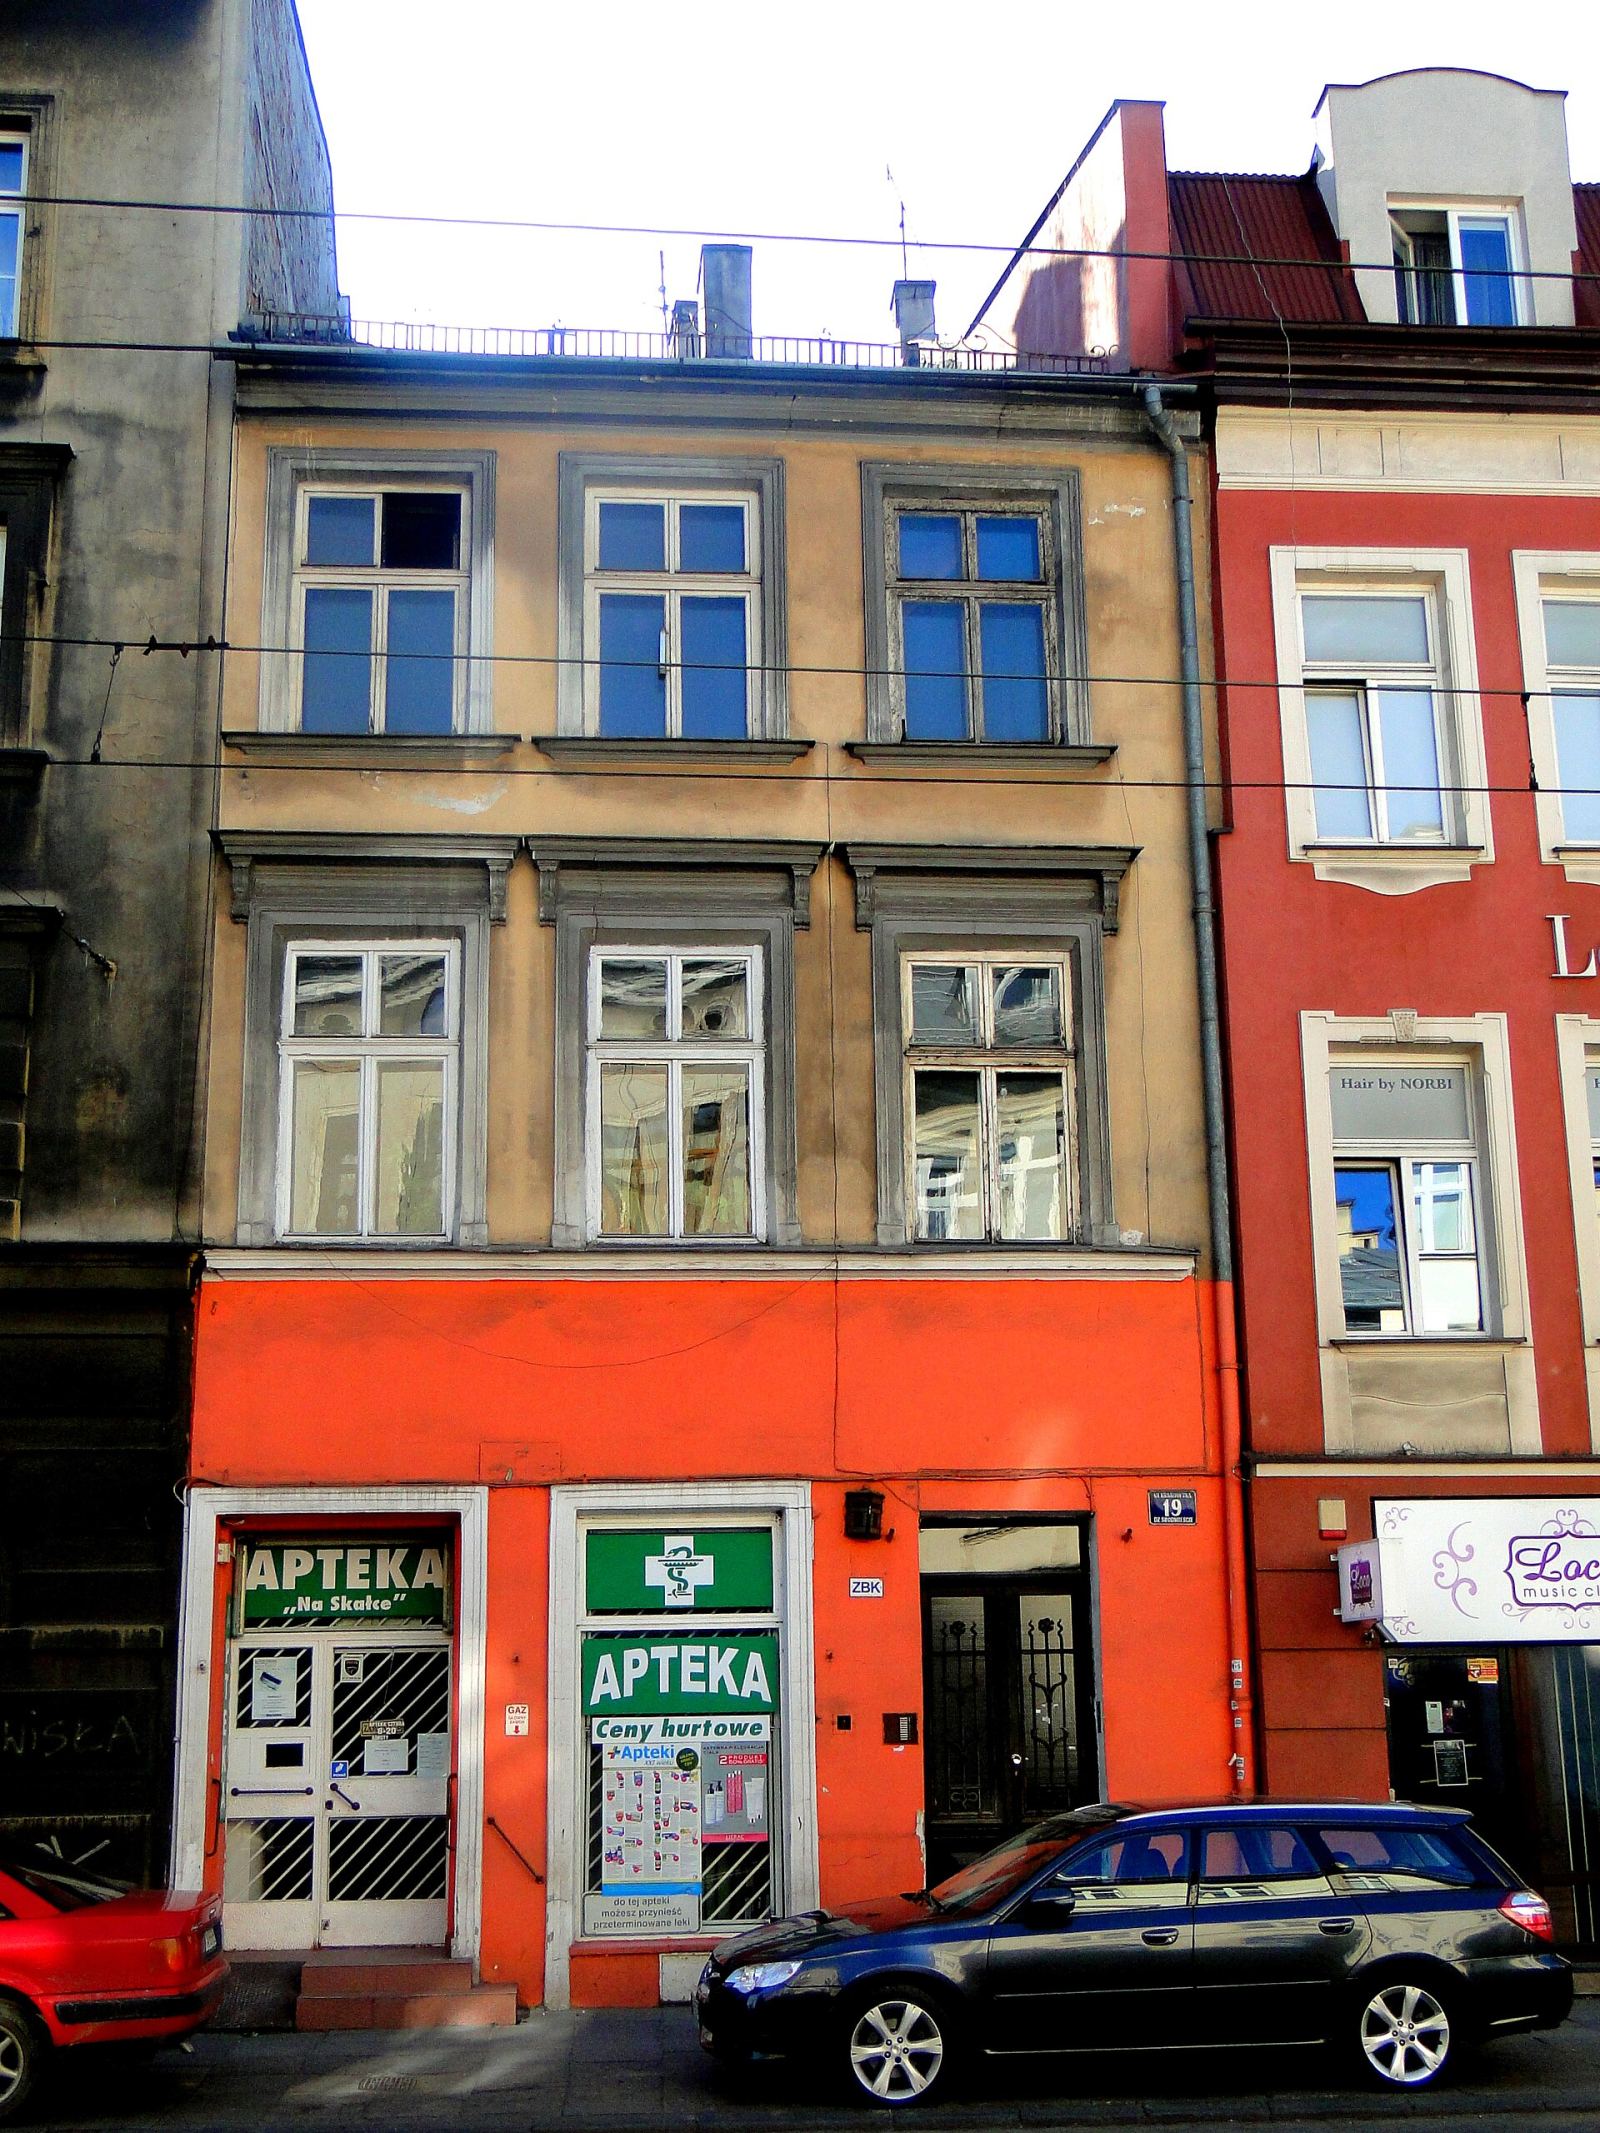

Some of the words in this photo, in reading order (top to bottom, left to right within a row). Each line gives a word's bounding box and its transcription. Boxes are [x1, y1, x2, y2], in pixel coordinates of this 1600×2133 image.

[1545, 915, 1600, 978] L
[1341, 1078, 1374, 1089] Hair
[1378, 1078, 1395, 1093] by
[1401, 1078, 1453, 1090] NORBI
[1163, 1498, 1182, 1517] 19
[1515, 1541, 1600, 1582] Loc
[246, 1549, 444, 1590] APTEKA
[852, 1581, 881, 1593] ZBK
[1523, 1585, 1577, 1598] music
[590, 1645, 772, 1706] APTEKA
[508, 1706, 527, 1714] GAZ
[596, 1719, 653, 1743] Ceny
[661, 1718, 763, 1738] hurtowe
[621, 1744, 675, 1762] Apteki
[720, 1755, 728, 1765] 2
[614, 1898, 626, 1906] do
[628, 1897, 640, 1908] tej
[642, 1896, 670, 1907] apteki
[601, 1908, 636, 1918] możesz
[639, 1907, 682, 1920] przynieść
[593, 1918, 672, 1931] przeterminowane
[674, 1917, 690, 1927] leki
